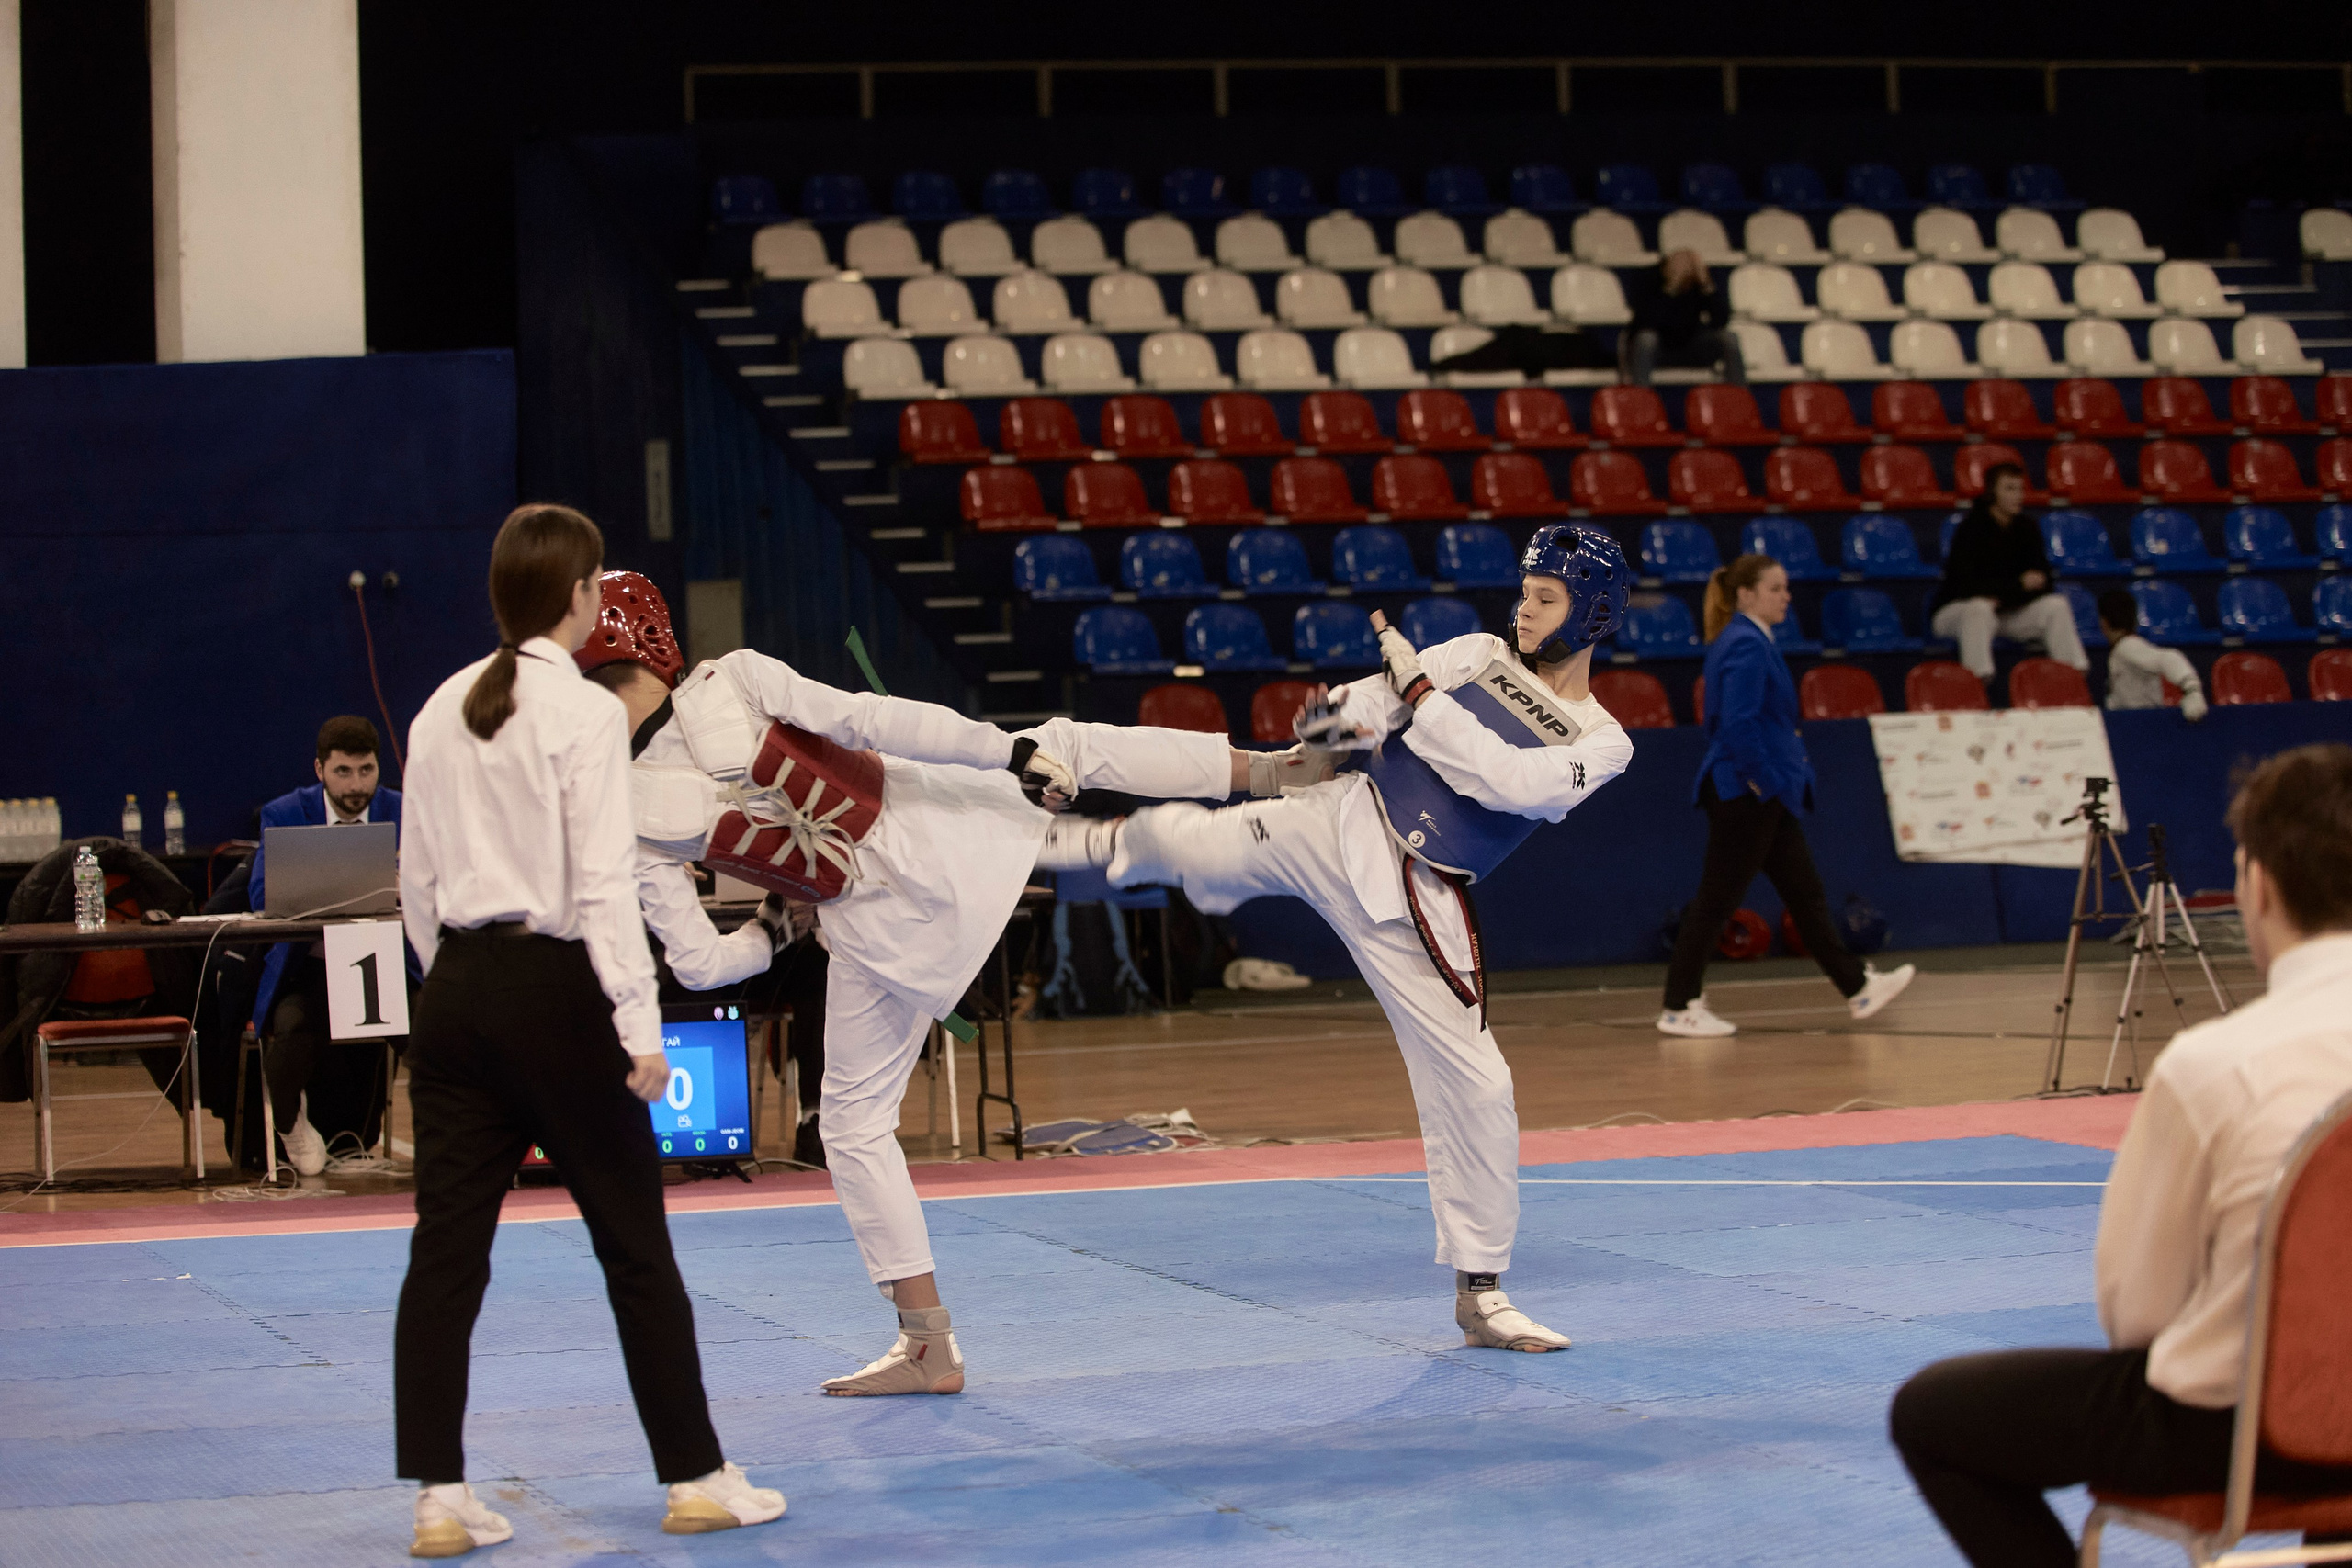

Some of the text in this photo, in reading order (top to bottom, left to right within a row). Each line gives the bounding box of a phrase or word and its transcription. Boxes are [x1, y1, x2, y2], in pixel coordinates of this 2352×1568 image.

[1489, 674, 1569, 737] KPNP
[1411, 833, 1422, 844] 3
[350, 952, 391, 1027] 1
[666, 1067, 693, 1111] 0
[662, 1139, 673, 1154] 0
[695, 1137, 706, 1152] 0
[728, 1136, 739, 1150] 0
